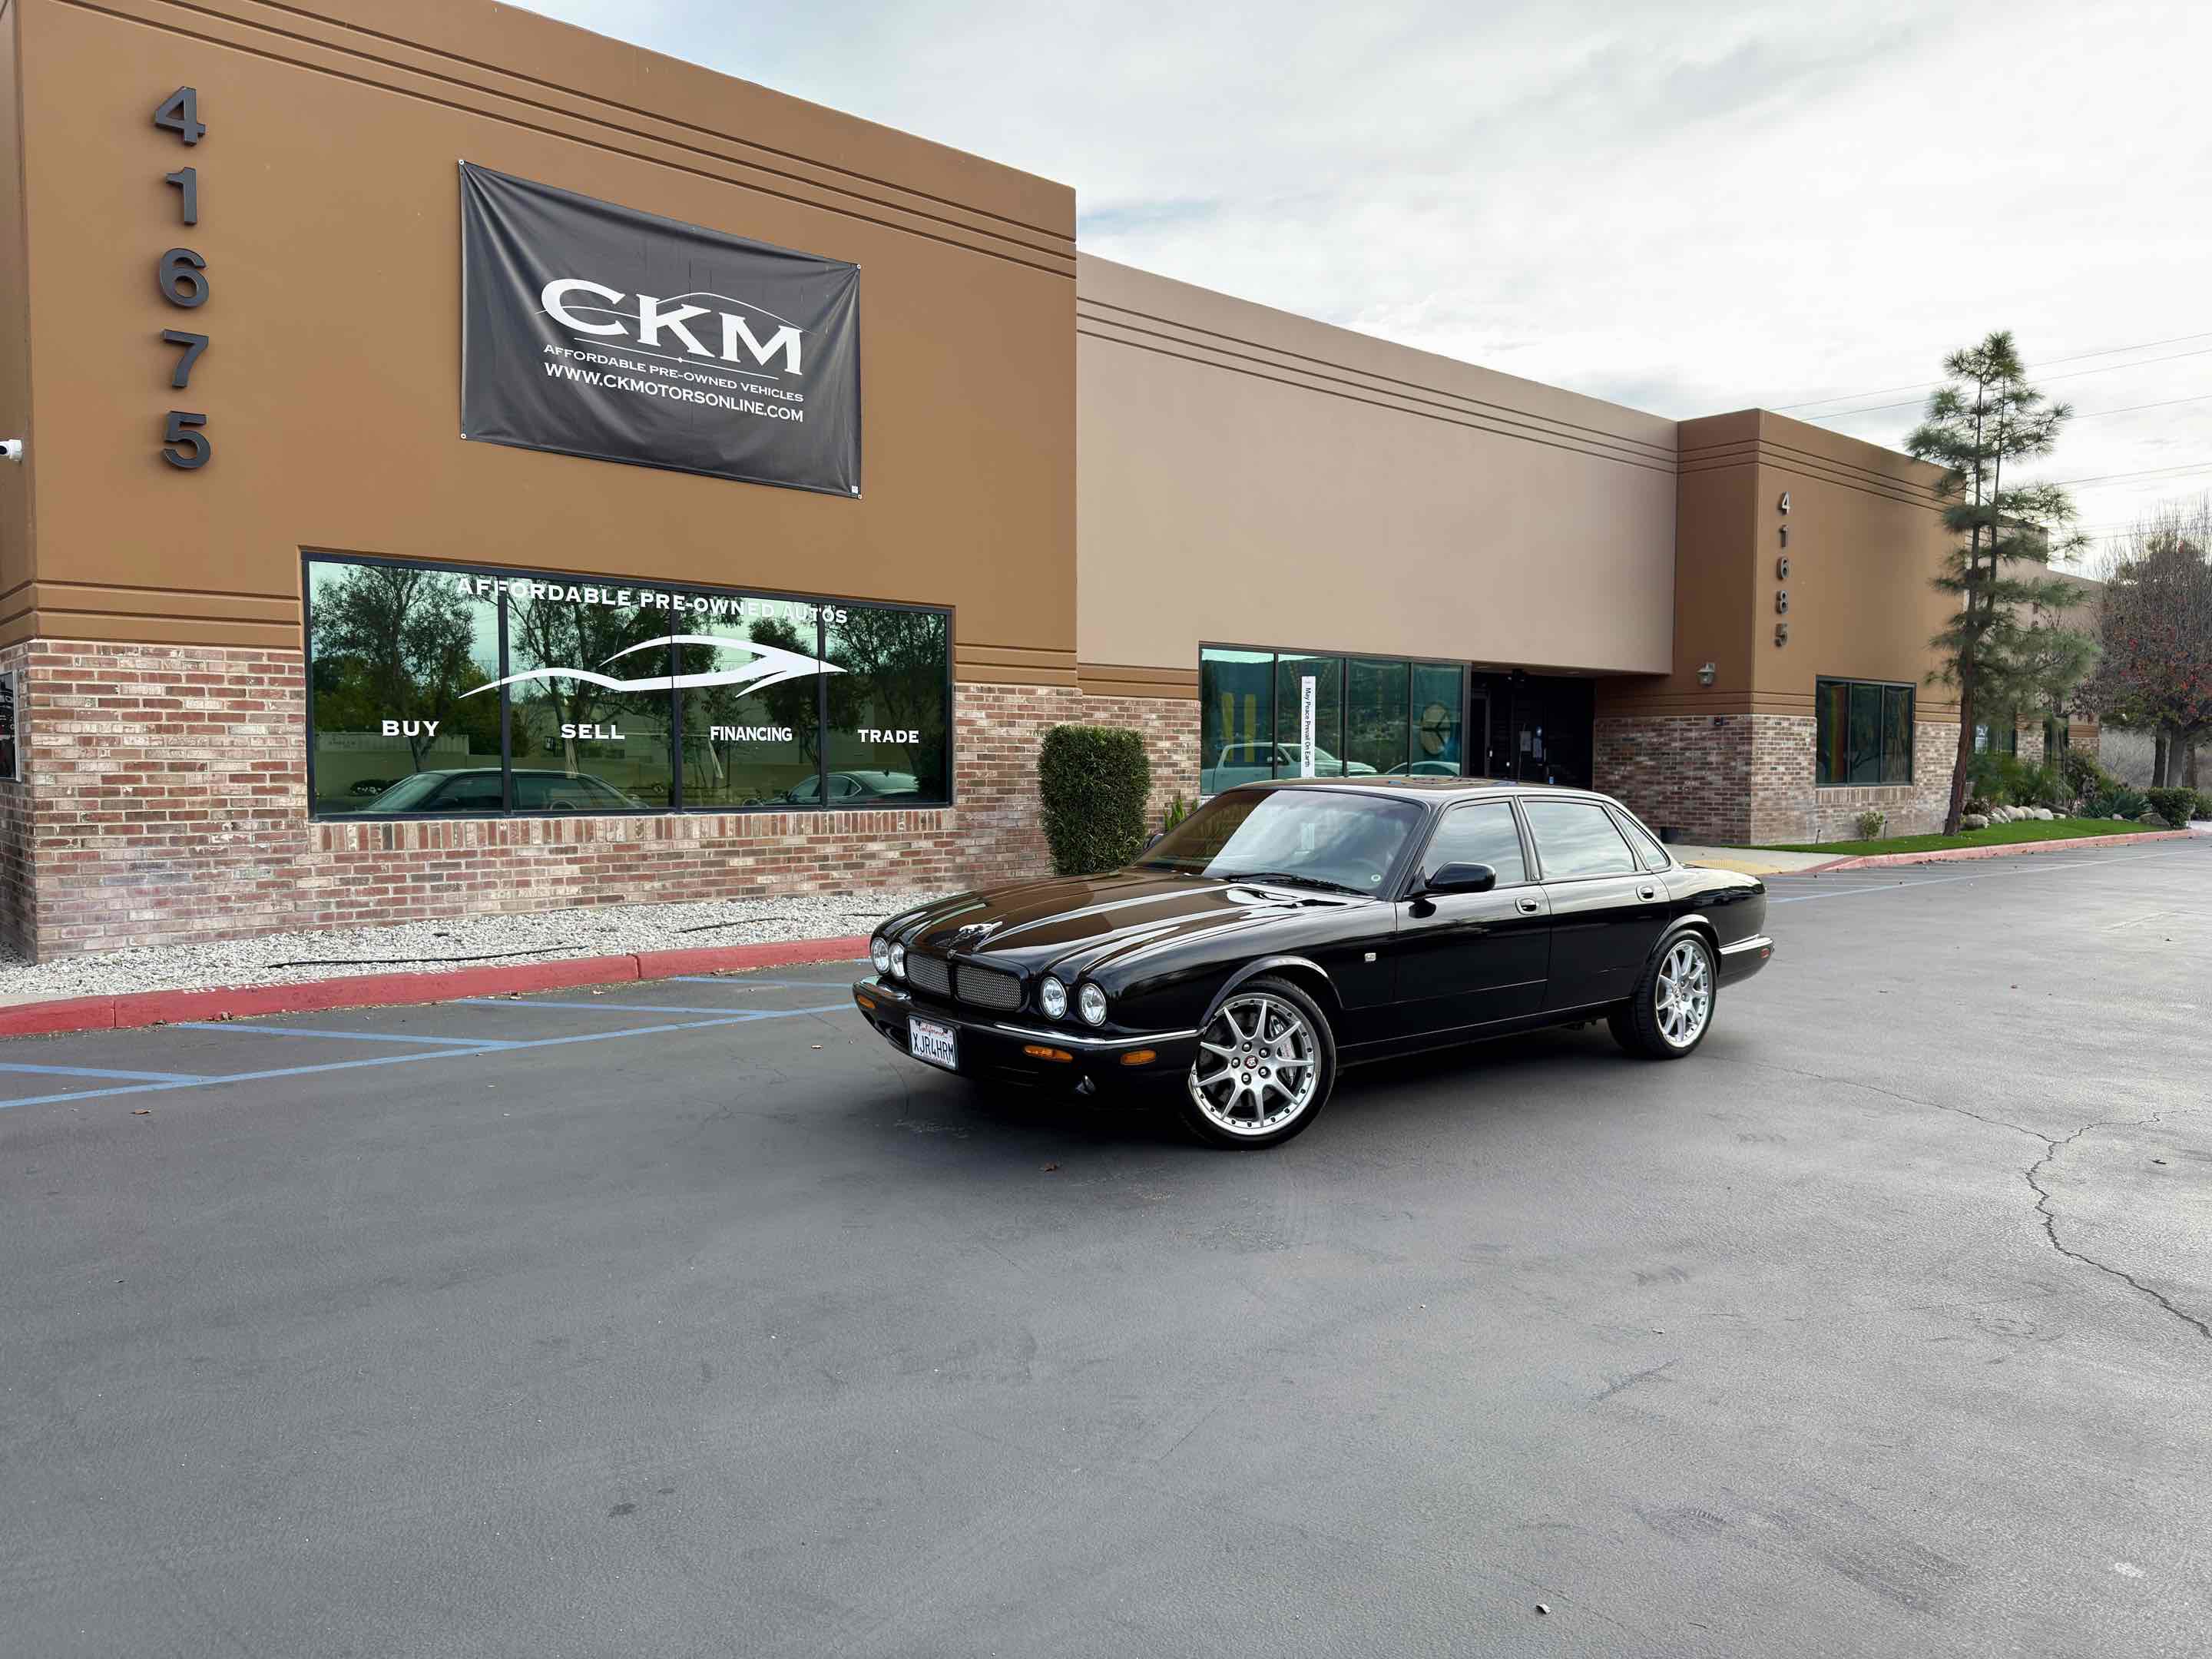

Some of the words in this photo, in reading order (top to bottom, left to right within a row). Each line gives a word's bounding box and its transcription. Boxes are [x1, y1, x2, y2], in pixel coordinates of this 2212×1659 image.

[154, 85, 212, 470] 41675
[541, 278, 803, 375] CKM
[544, 343, 647, 373] AFFORDABLE
[649, 365, 737, 389] PRE-OWNED
[740, 382, 804, 402] VEHICLES
[544, 362, 803, 422] WWW.CKMOTORSONLINE.COM
[1775, 491, 1790, 647] 41685
[455, 578, 631, 606] AFFORDABLE
[640, 591, 776, 618] PRE-OWNED
[783, 605, 848, 624] AUTOS
[382, 720, 440, 737] BUY
[561, 724, 625, 740] SELL
[710, 726, 793, 742] FINANCING
[857, 729, 919, 743] TRADE
[1304, 741, 1312, 750] On
